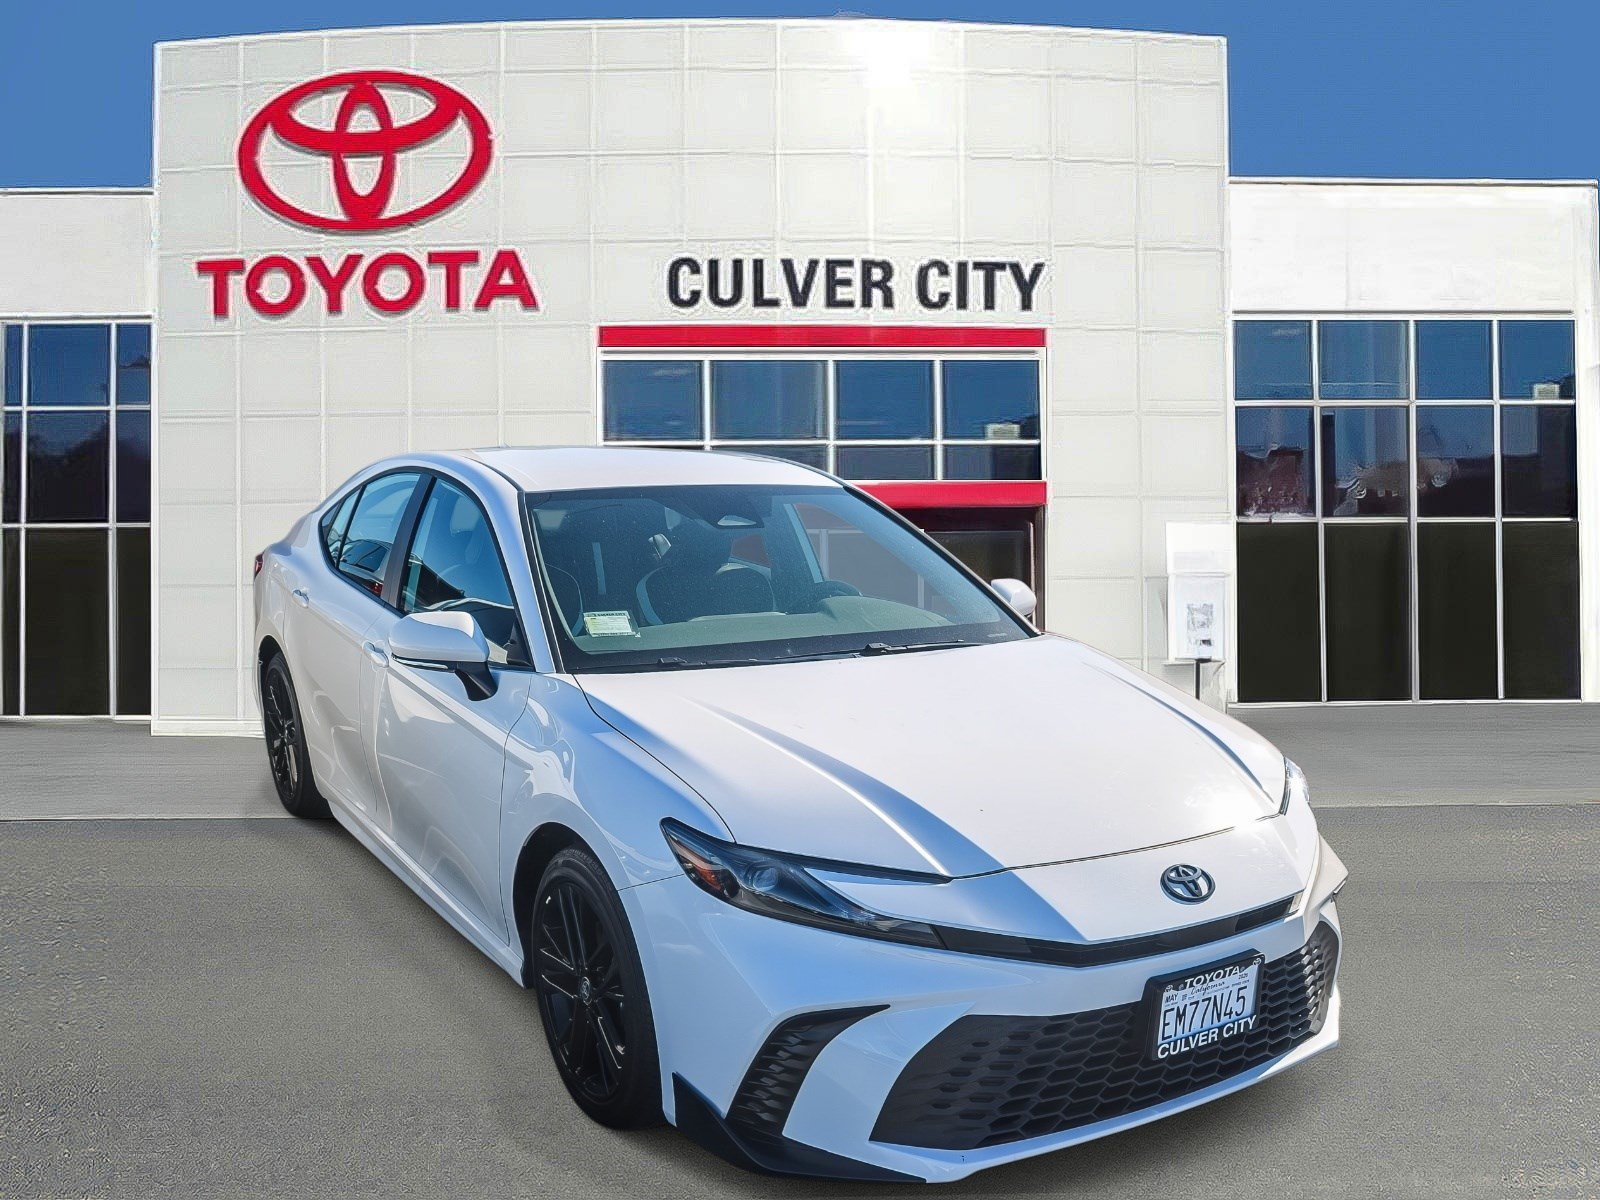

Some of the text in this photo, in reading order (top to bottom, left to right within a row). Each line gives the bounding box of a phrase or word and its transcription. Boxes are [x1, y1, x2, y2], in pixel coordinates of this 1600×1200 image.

[197, 249, 539, 318] TOYOTA
[667, 257, 1046, 311] CULVER CITY
[1165, 993, 1178, 1004] MAY
[1185, 966, 1240, 989] TOYOTA
[1157, 1015, 1257, 1059] CULVER CITY
[1162, 986, 1248, 1041] EM77N45
